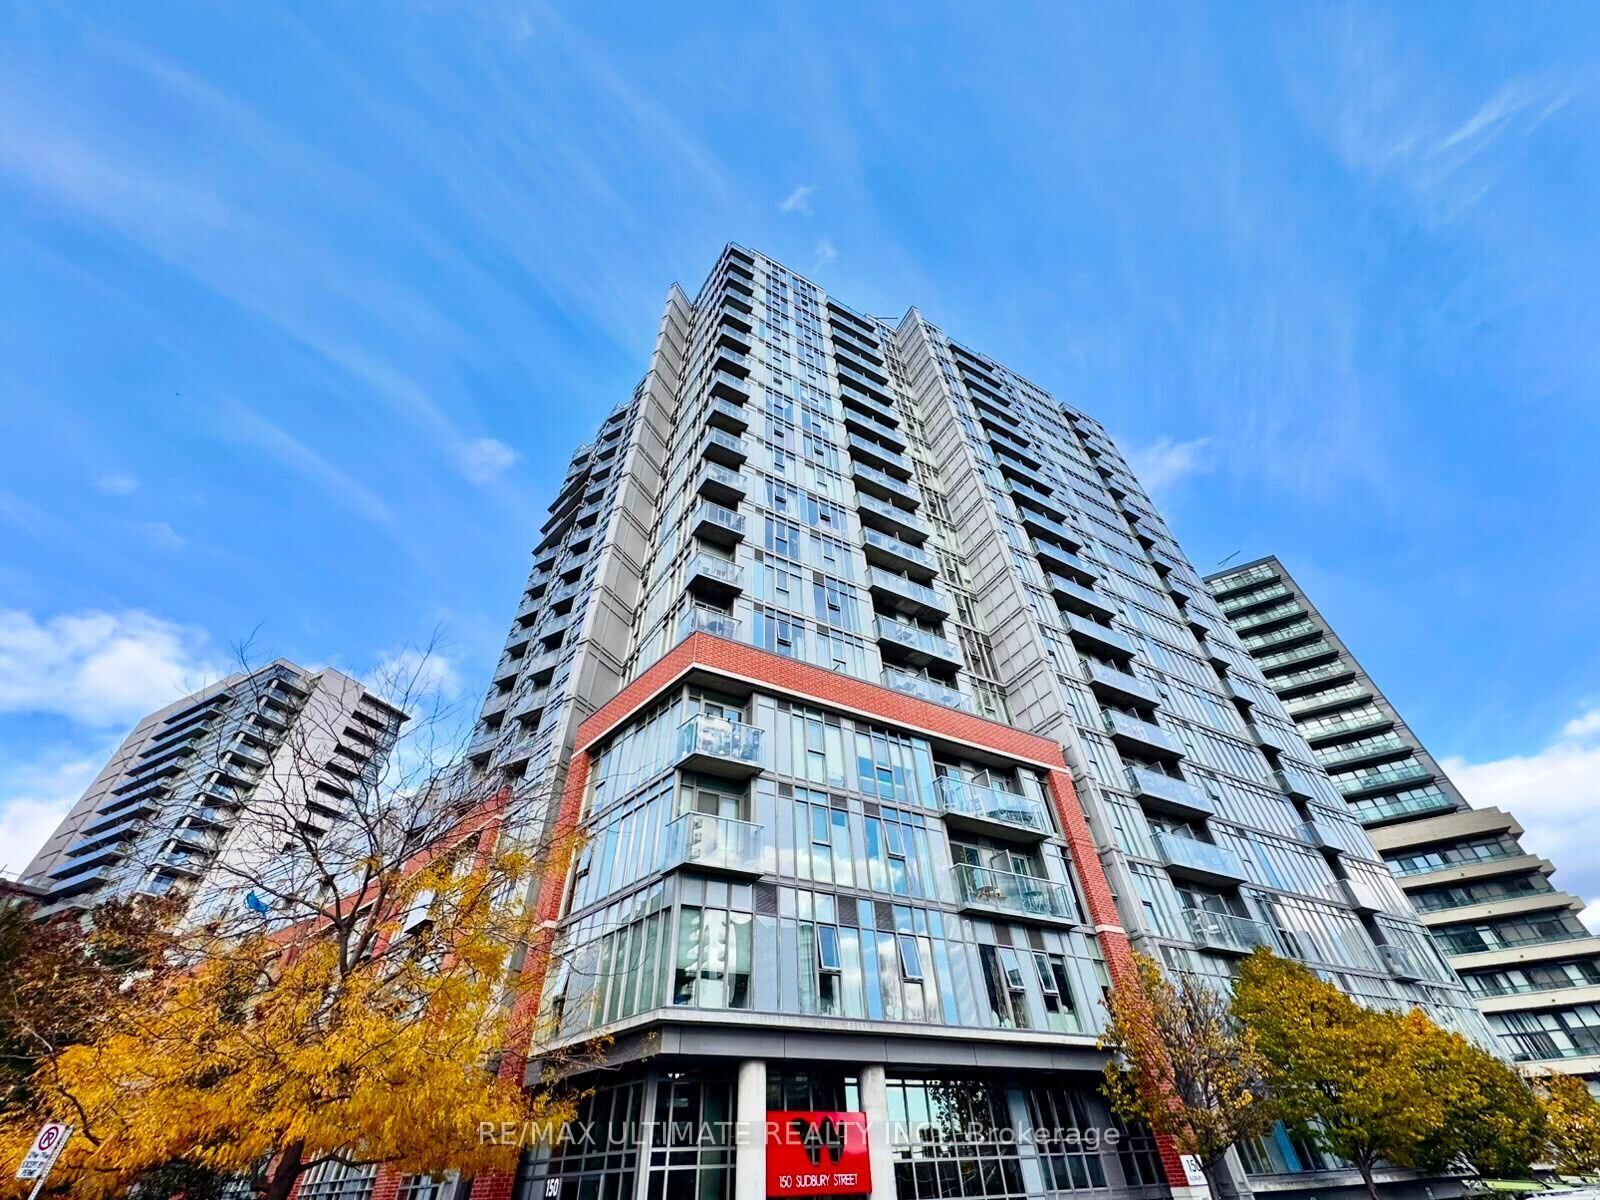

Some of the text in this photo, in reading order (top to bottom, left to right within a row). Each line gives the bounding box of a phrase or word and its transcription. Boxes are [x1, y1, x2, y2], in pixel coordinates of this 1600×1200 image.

[545, 1178, 560, 1197] 150
[779, 1173, 858, 1188] 150 SUDBURY STREET
